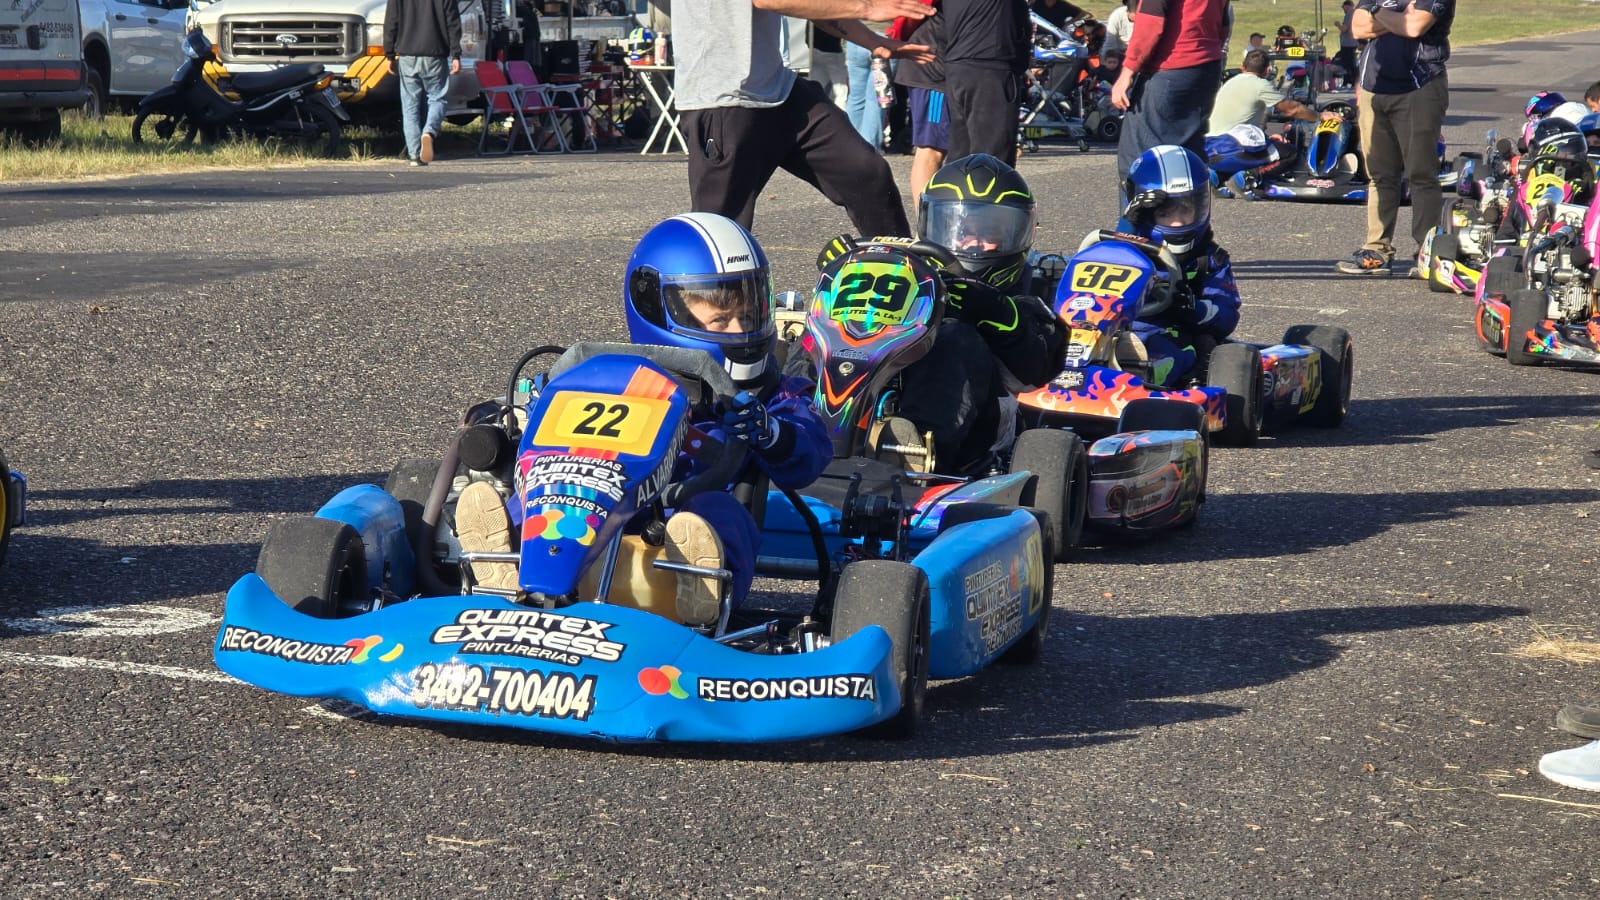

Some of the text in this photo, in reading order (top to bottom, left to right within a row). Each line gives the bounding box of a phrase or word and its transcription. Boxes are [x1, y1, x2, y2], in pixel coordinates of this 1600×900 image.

[727, 255, 750, 264] HAWK
[832, 272, 912, 312] 29
[1076, 264, 1132, 292] 32
[832, 309, 881, 317] BAUTISTA
[572, 402, 630, 437] 22
[526, 462, 626, 488] QUIMTEX
[535, 455, 622, 471] PINTURERIAS
[526, 473, 624, 502] EXPRESS
[526, 495, 608, 519] RECONQUISTA
[458, 609, 612, 639] QUIMTEX
[221, 628, 353, 665] RECONQUISTA
[433, 624, 624, 661] EXPRESS
[464, 642, 580, 664] PINTURERIAS
[413, 664, 593, 718] 3482-700404
[699, 677, 874, 699] RECONQUISTA
